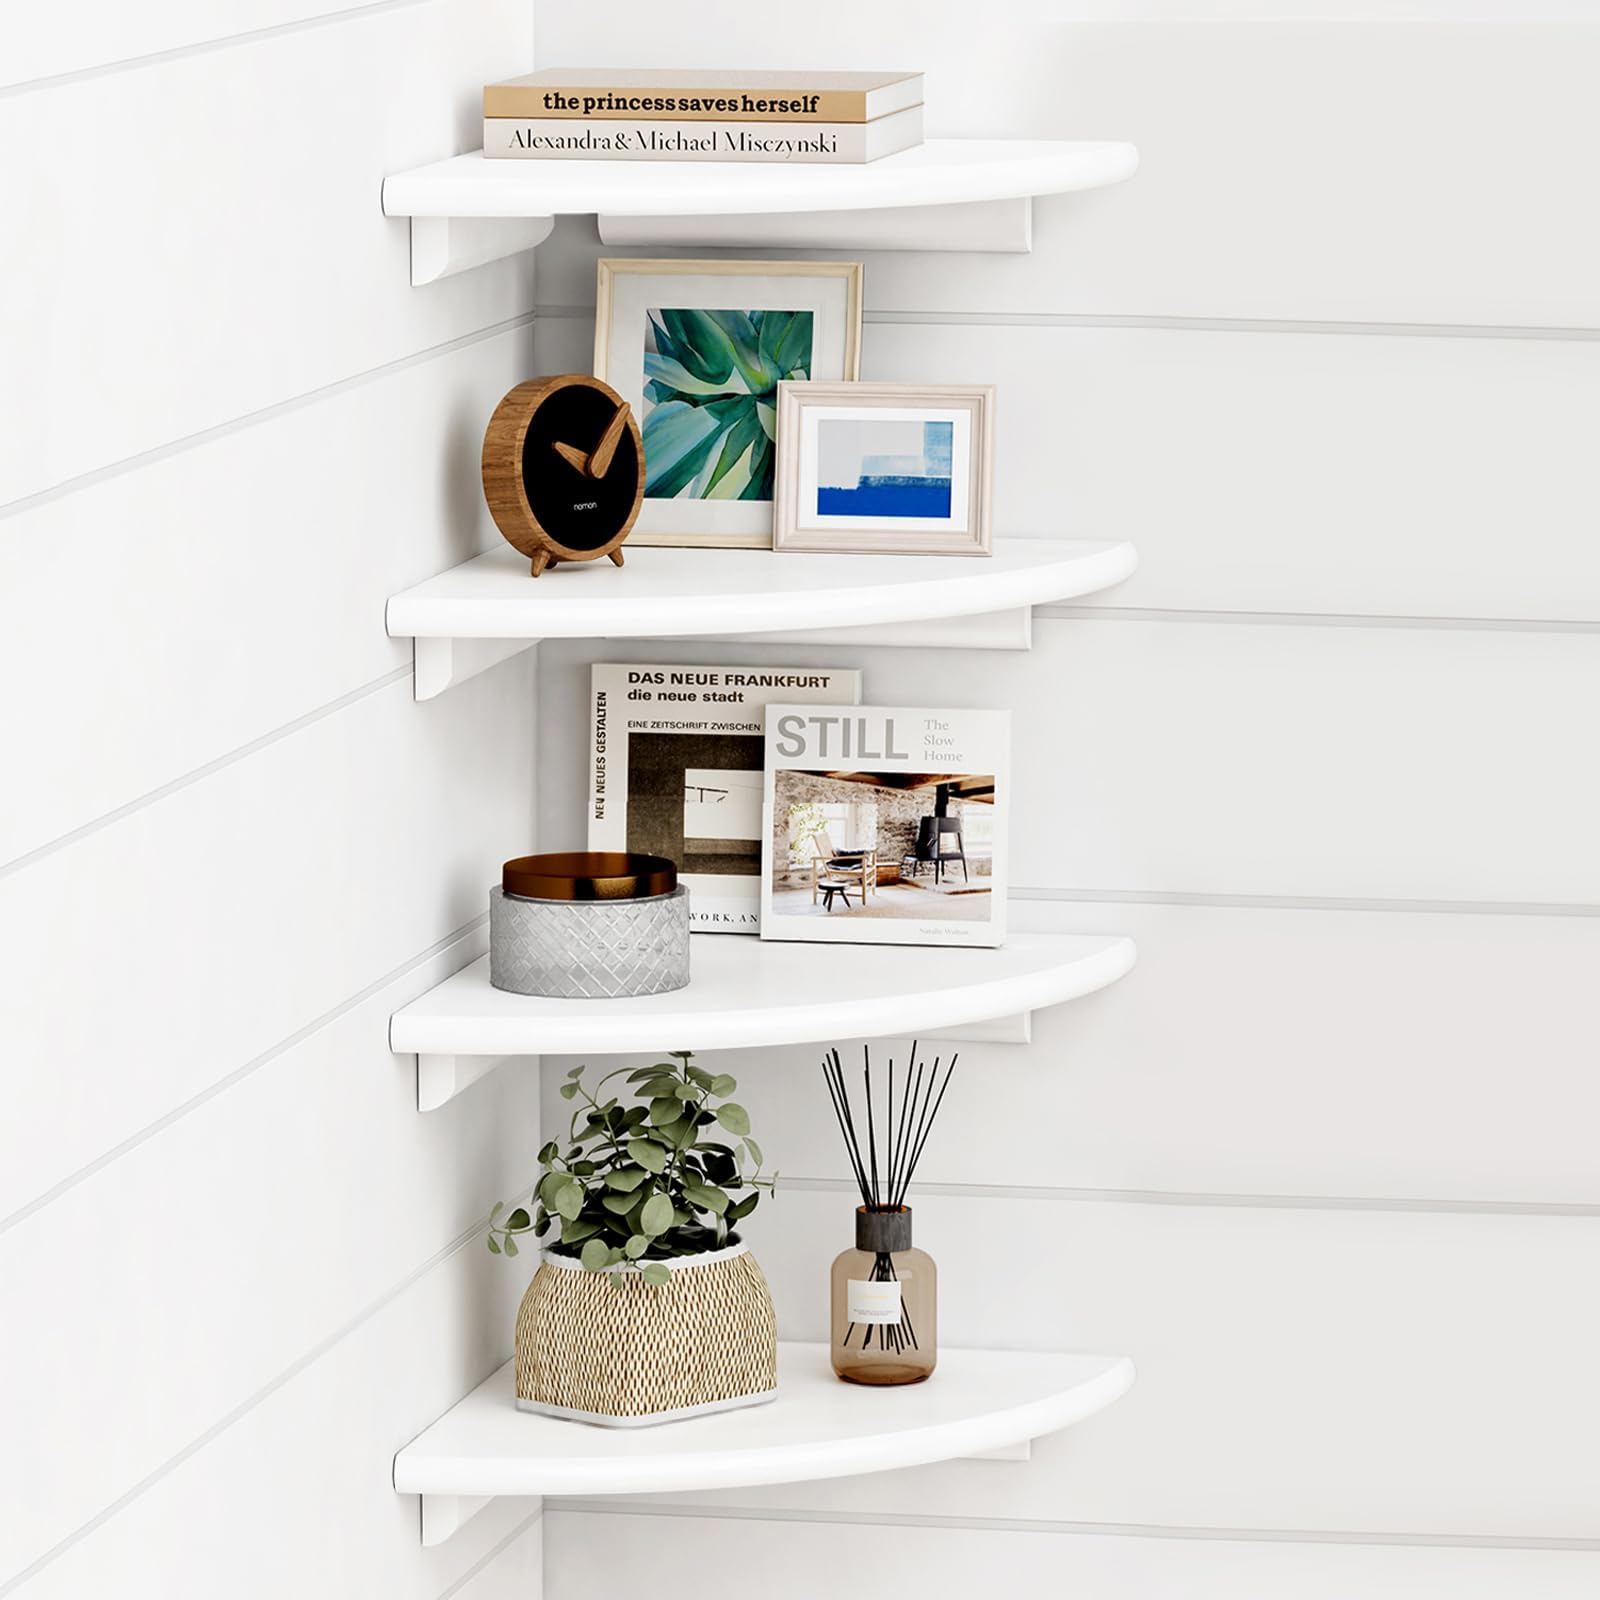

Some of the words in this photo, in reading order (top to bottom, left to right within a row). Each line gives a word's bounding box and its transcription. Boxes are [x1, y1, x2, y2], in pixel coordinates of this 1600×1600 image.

[542, 91, 580, 111] the
[582, 93, 676, 115] princess
[678, 97, 739, 113] saves
[740, 94, 822, 114] herself
[508, 129, 612, 150] Alexandra
[614, 131, 632, 151] &
[634, 130, 717, 152] Michael
[724, 132, 838, 159] Misczynski
[573, 501, 598, 511] nomon
[628, 671, 666, 685] DAS
[670, 672, 719, 686] NEUE
[724, 674, 831, 689] FRANKFURT
[627, 688, 652, 701] die
[657, 691, 697, 702] neue
[702, 690, 745, 703] stadt
[596, 691, 607, 754] GESTALTEN
[627, 720, 648, 729] EINE
[650, 721, 709, 731] ZEITSCHRIFT
[710, 722, 761, 732] ZWISCHEN
[923, 719, 949, 731] The
[775, 715, 909, 760] STILL
[923, 735, 955, 747] Slow
[923, 750, 963, 762] Home
[596, 756, 606, 794] NEUES
